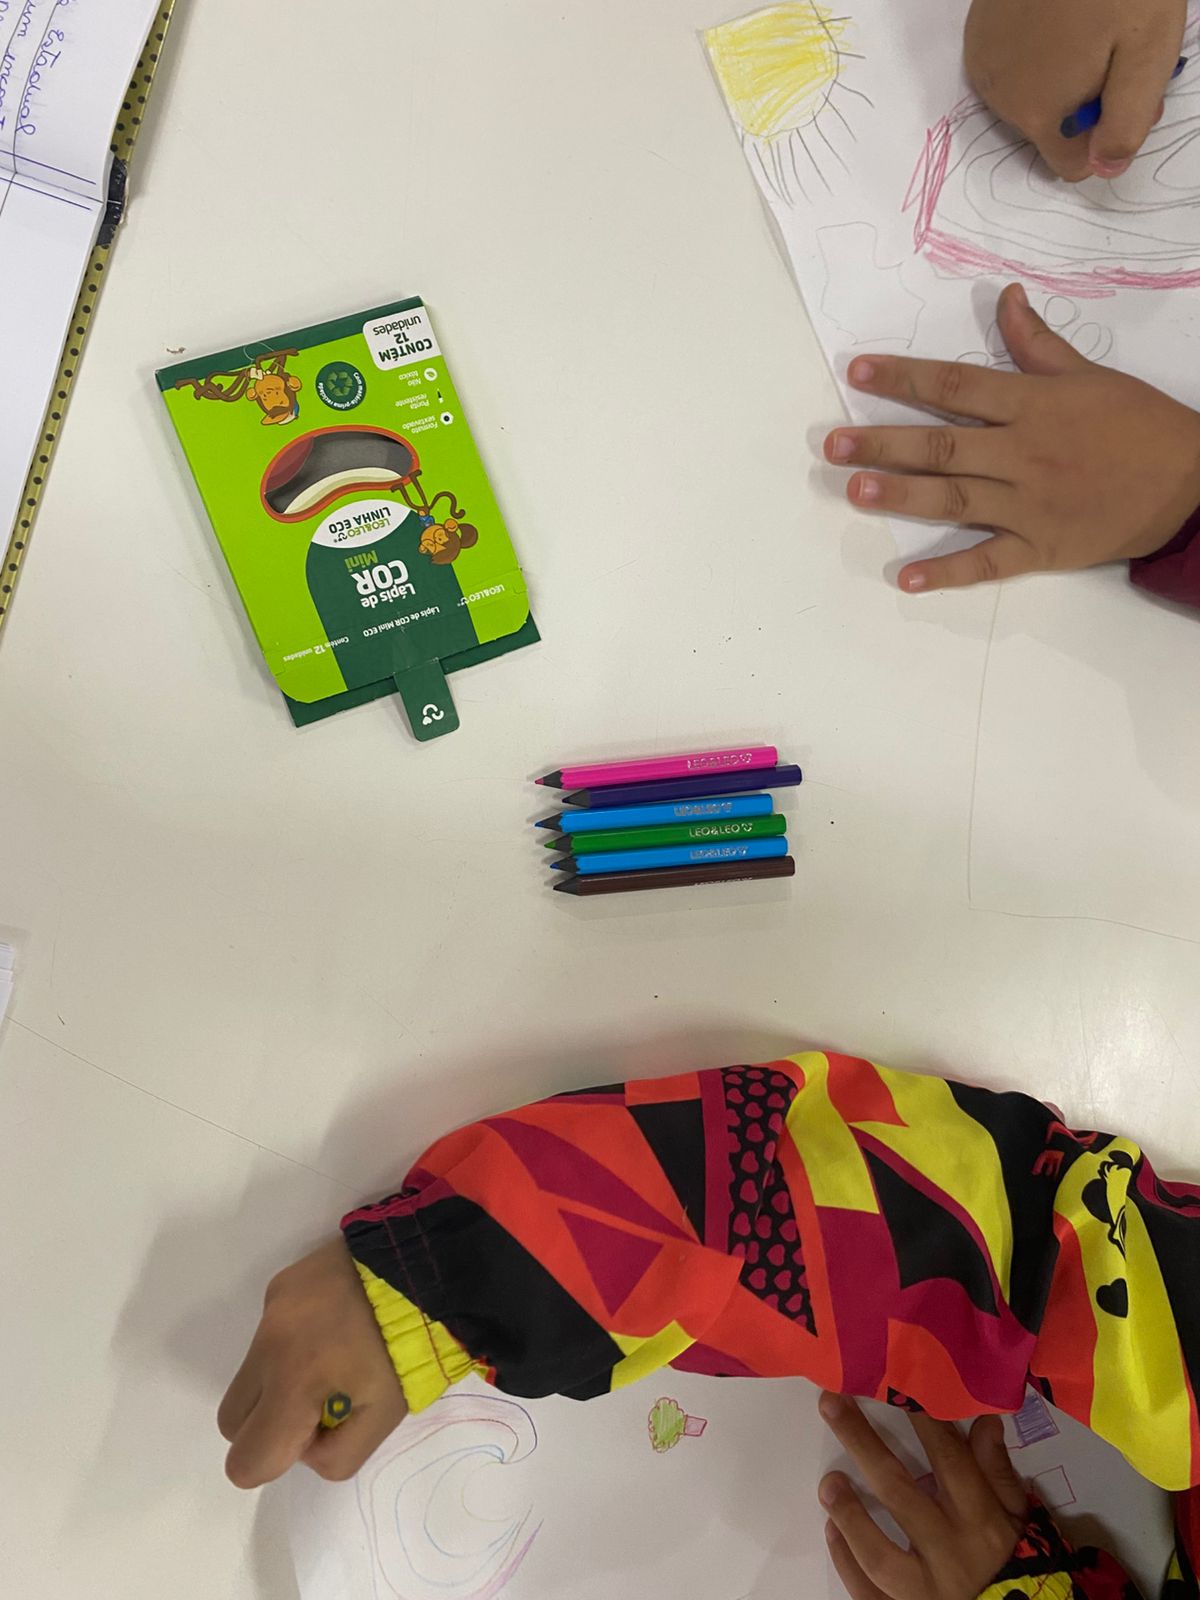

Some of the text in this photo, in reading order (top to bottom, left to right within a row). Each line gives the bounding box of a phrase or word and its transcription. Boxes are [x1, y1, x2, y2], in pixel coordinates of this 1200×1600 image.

[15, 29, 64, 135] Estadual
[372, 315, 422, 336] unidades
[394, 332, 410, 344] 12
[378, 338, 433, 362] CONTÉM
[328, 506, 391, 533] LINHA ECO
[347, 518, 391, 538] LEO&LEO
[344, 550, 378, 572] Mini
[351, 559, 409, 595] COR
[360, 582, 416, 608] Lápis de
[468, 583, 505, 603] LEO&LEO
[363, 606, 440, 637] Lápis de COR Mini ECO
[313, 644, 326, 655] 12
[689, 824, 741, 838] LEO&LEO
